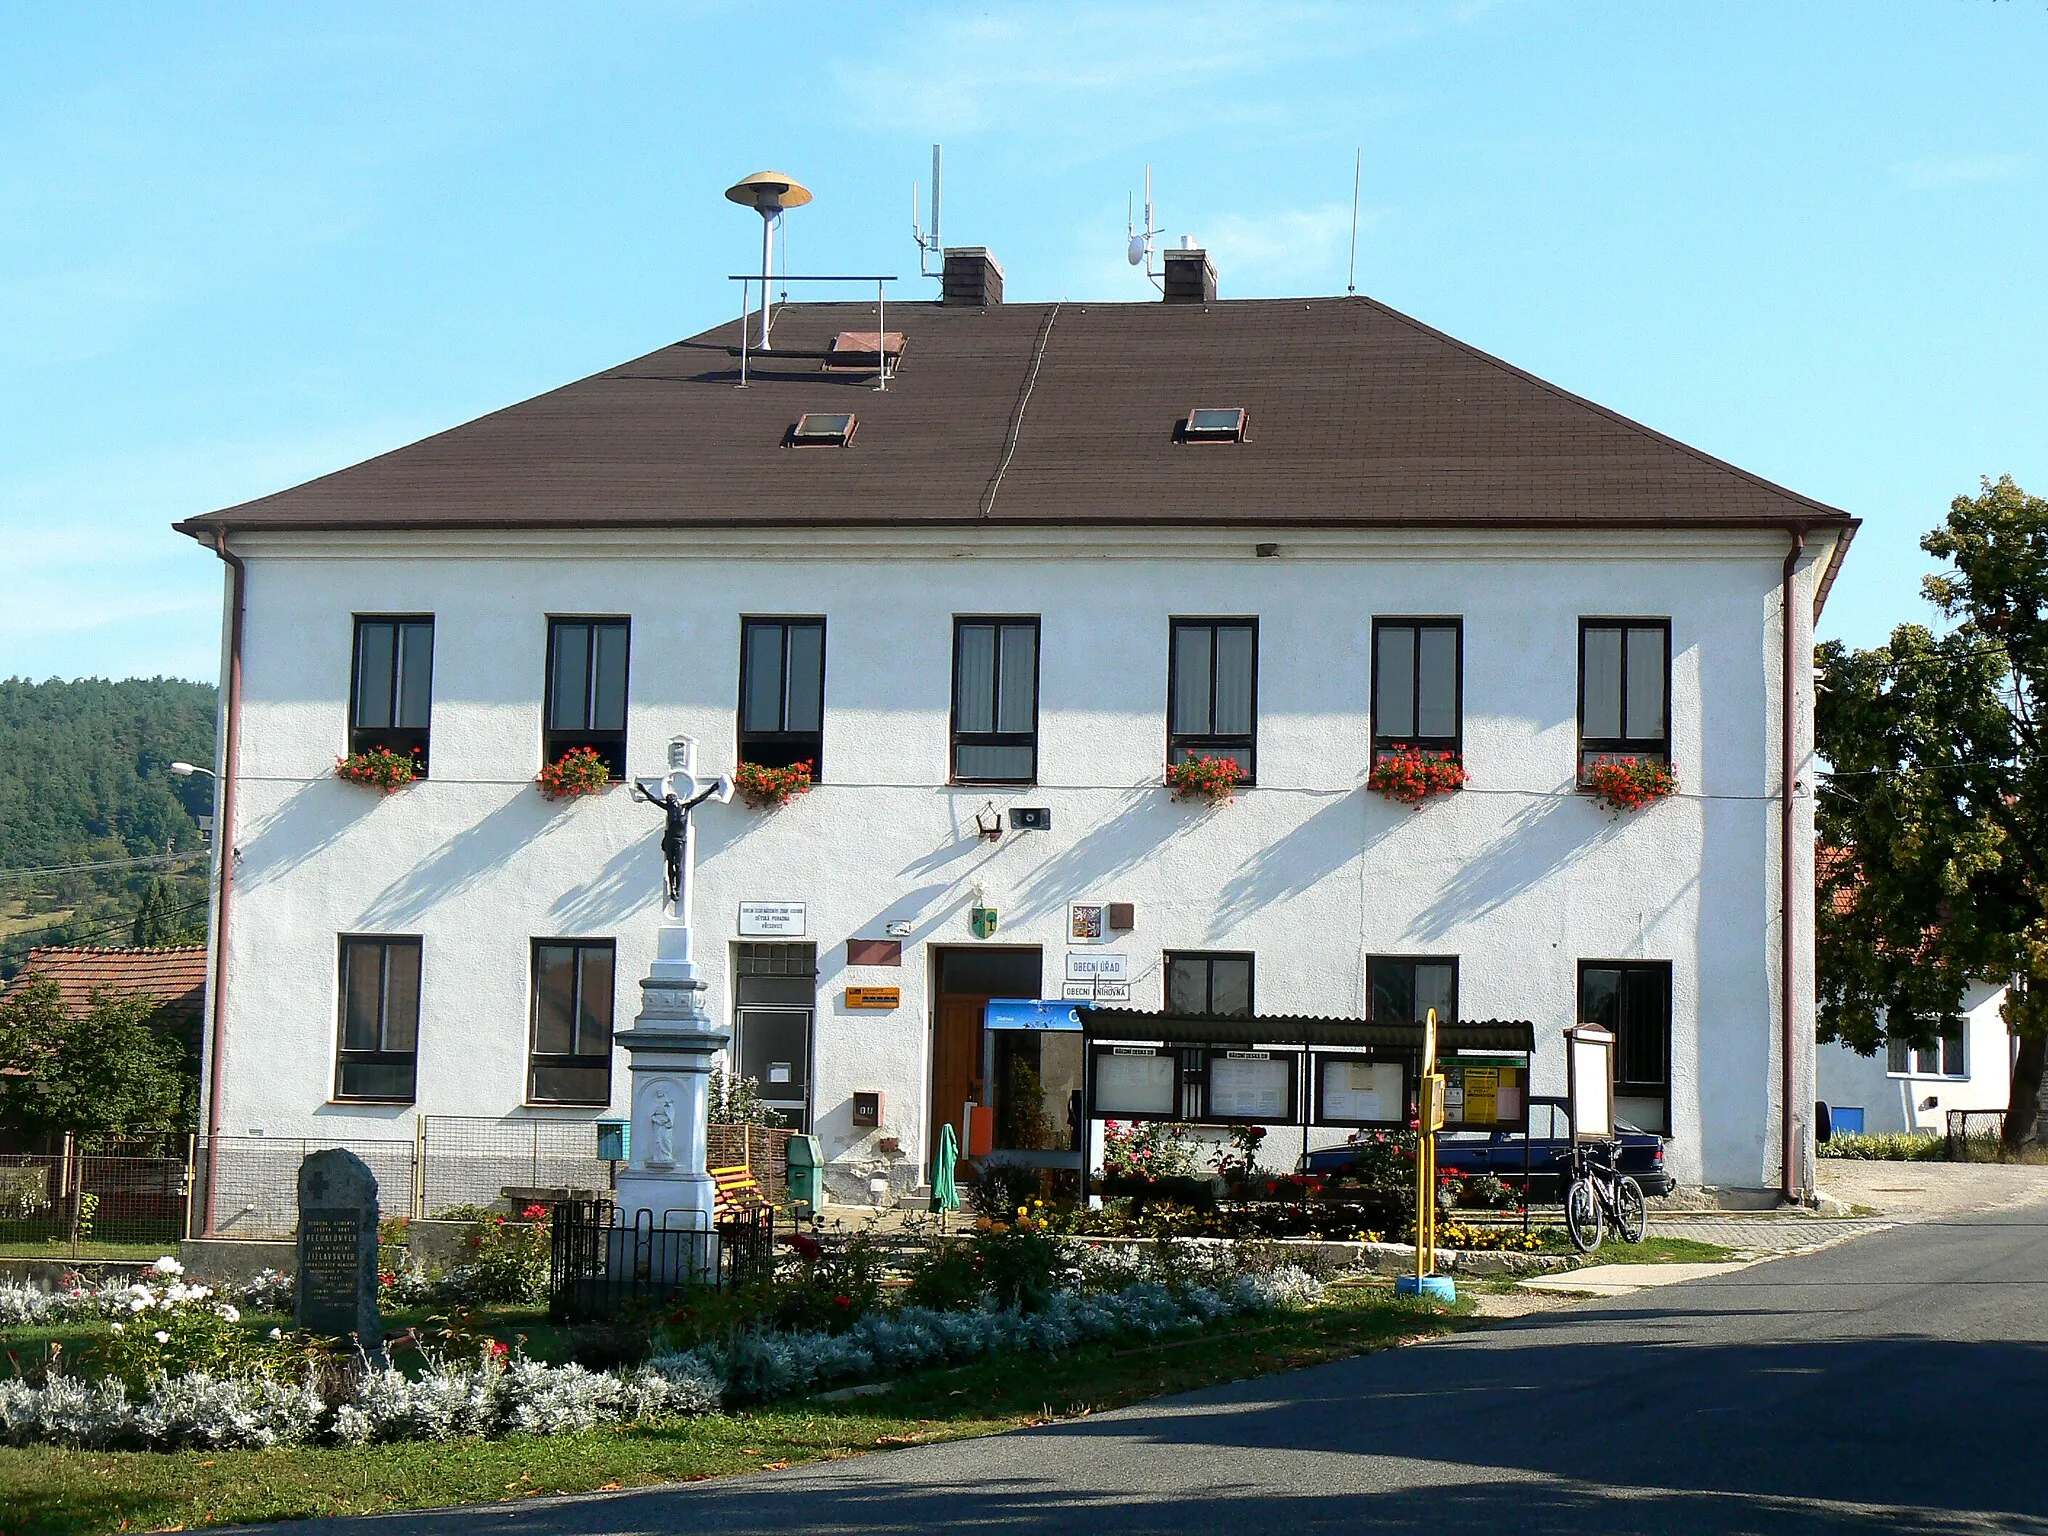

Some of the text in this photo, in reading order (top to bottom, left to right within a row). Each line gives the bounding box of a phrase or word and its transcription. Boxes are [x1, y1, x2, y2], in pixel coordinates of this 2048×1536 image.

[1073, 961, 1120, 972] OBECNÍ ÚŘAD
[1066, 986, 1091, 996] OBECNÍ
